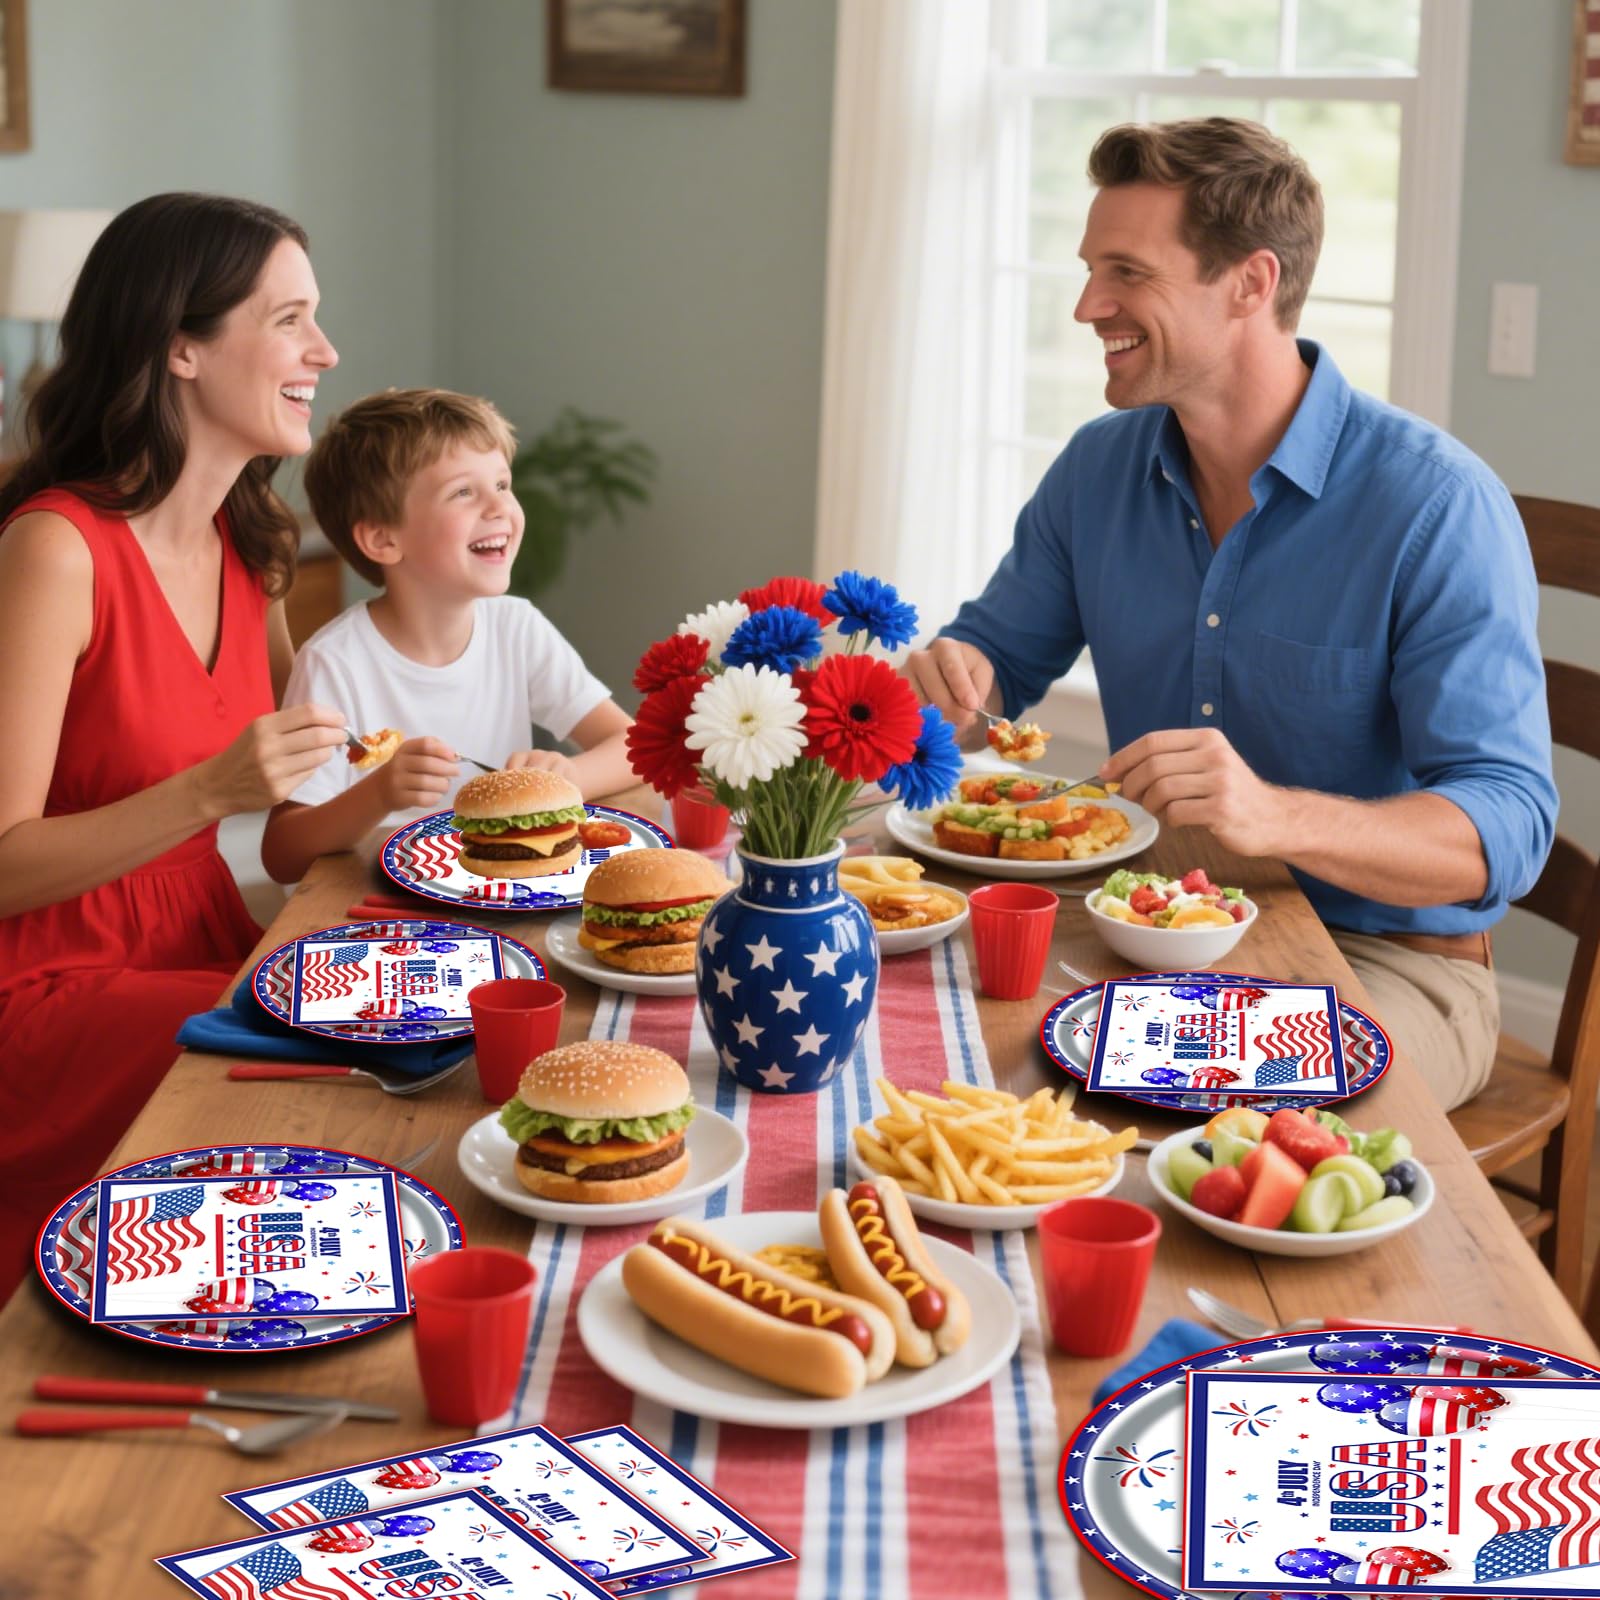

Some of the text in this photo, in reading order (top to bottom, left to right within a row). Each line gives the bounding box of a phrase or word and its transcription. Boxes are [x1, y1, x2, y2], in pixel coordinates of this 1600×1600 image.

[391, 960, 438, 998] USA
[1173, 1012, 1228, 1060] USA
[237, 1212, 306, 1276] USA
[319, 1237, 342, 1257] JULY
[1278, 1460, 1309, 1491] JULY
[1329, 1439, 1428, 1533] USA
[535, 1501, 580, 1523] JULY
[359, 1549, 487, 1600] US
[468, 1565, 513, 1586] JULY
